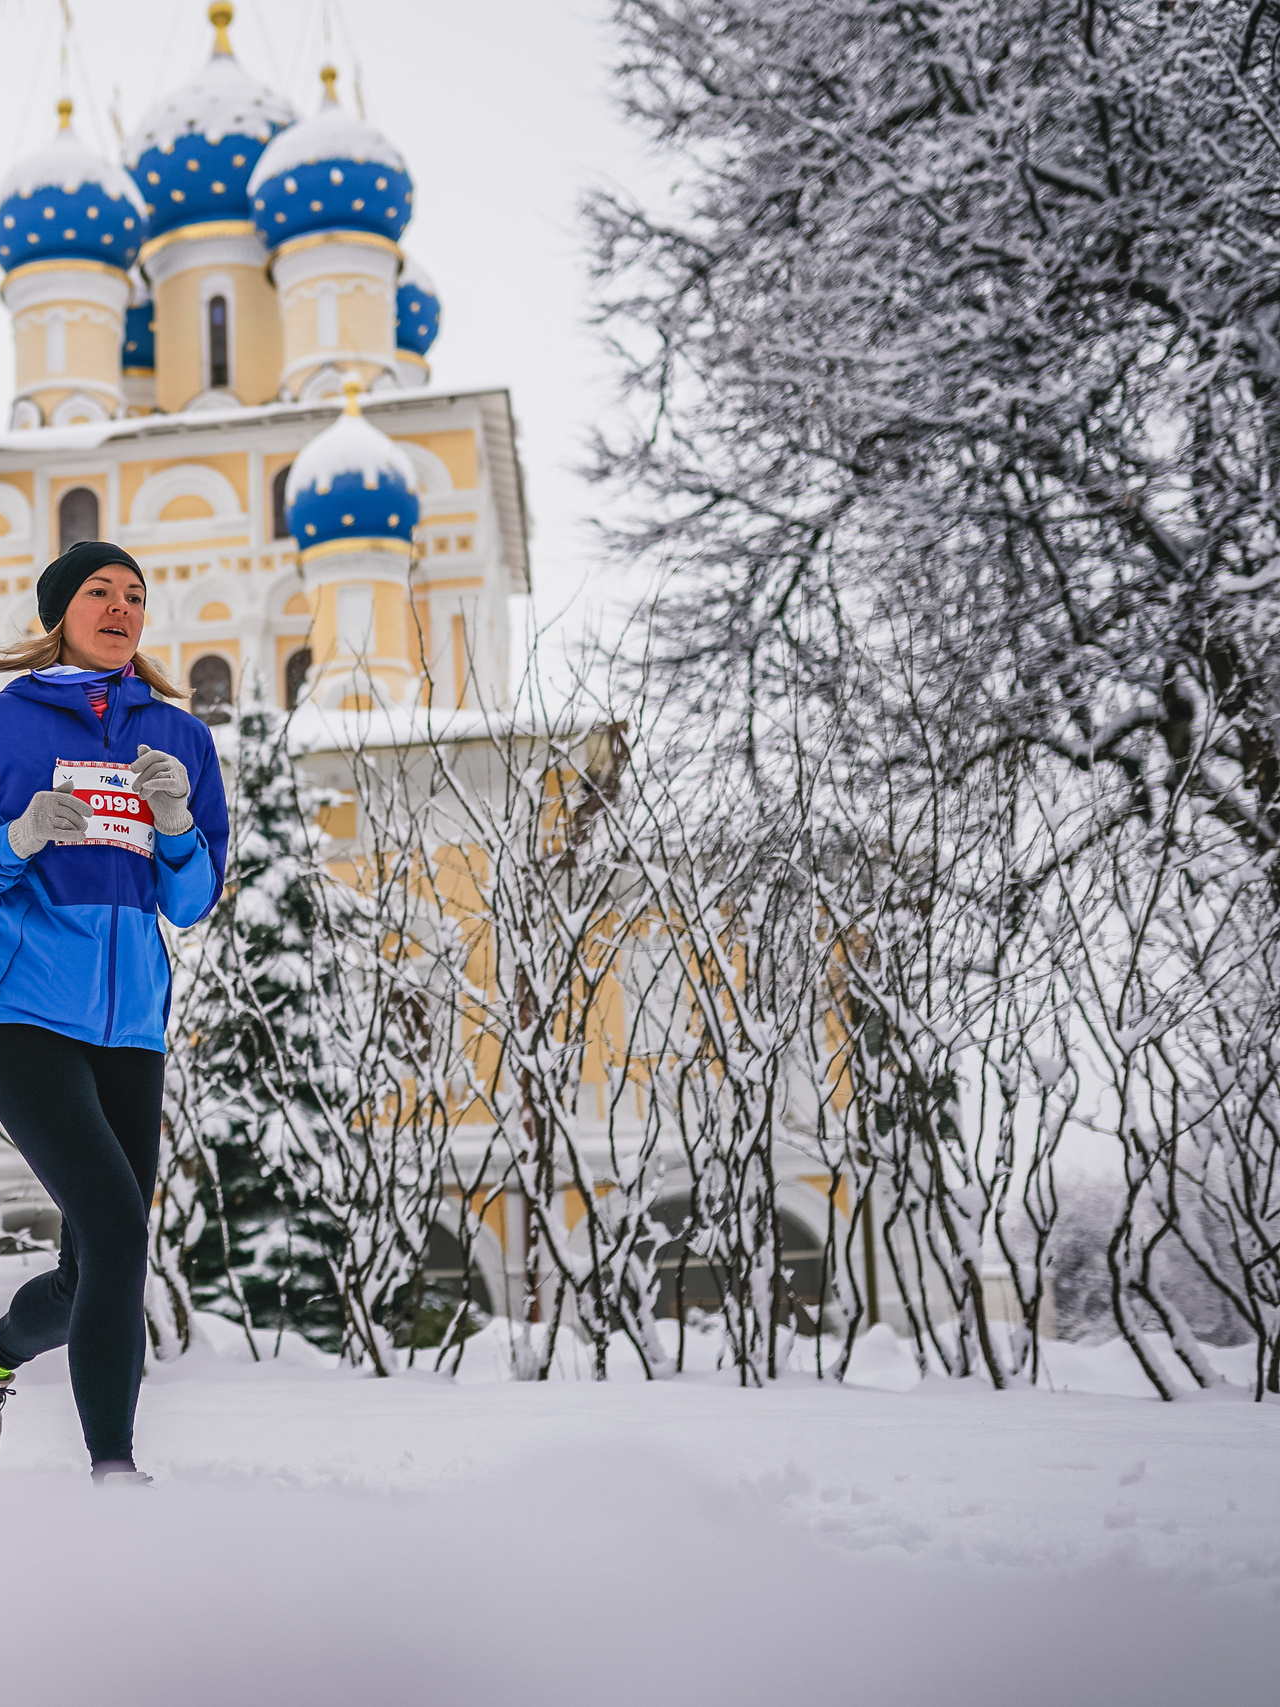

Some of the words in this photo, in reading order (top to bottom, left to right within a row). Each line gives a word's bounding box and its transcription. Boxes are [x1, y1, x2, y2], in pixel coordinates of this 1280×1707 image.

[100, 774, 129, 788] TRAIL
[90, 794, 140, 814] 0198
[103, 823, 110, 831] 7
[113, 823, 130, 834] KM
